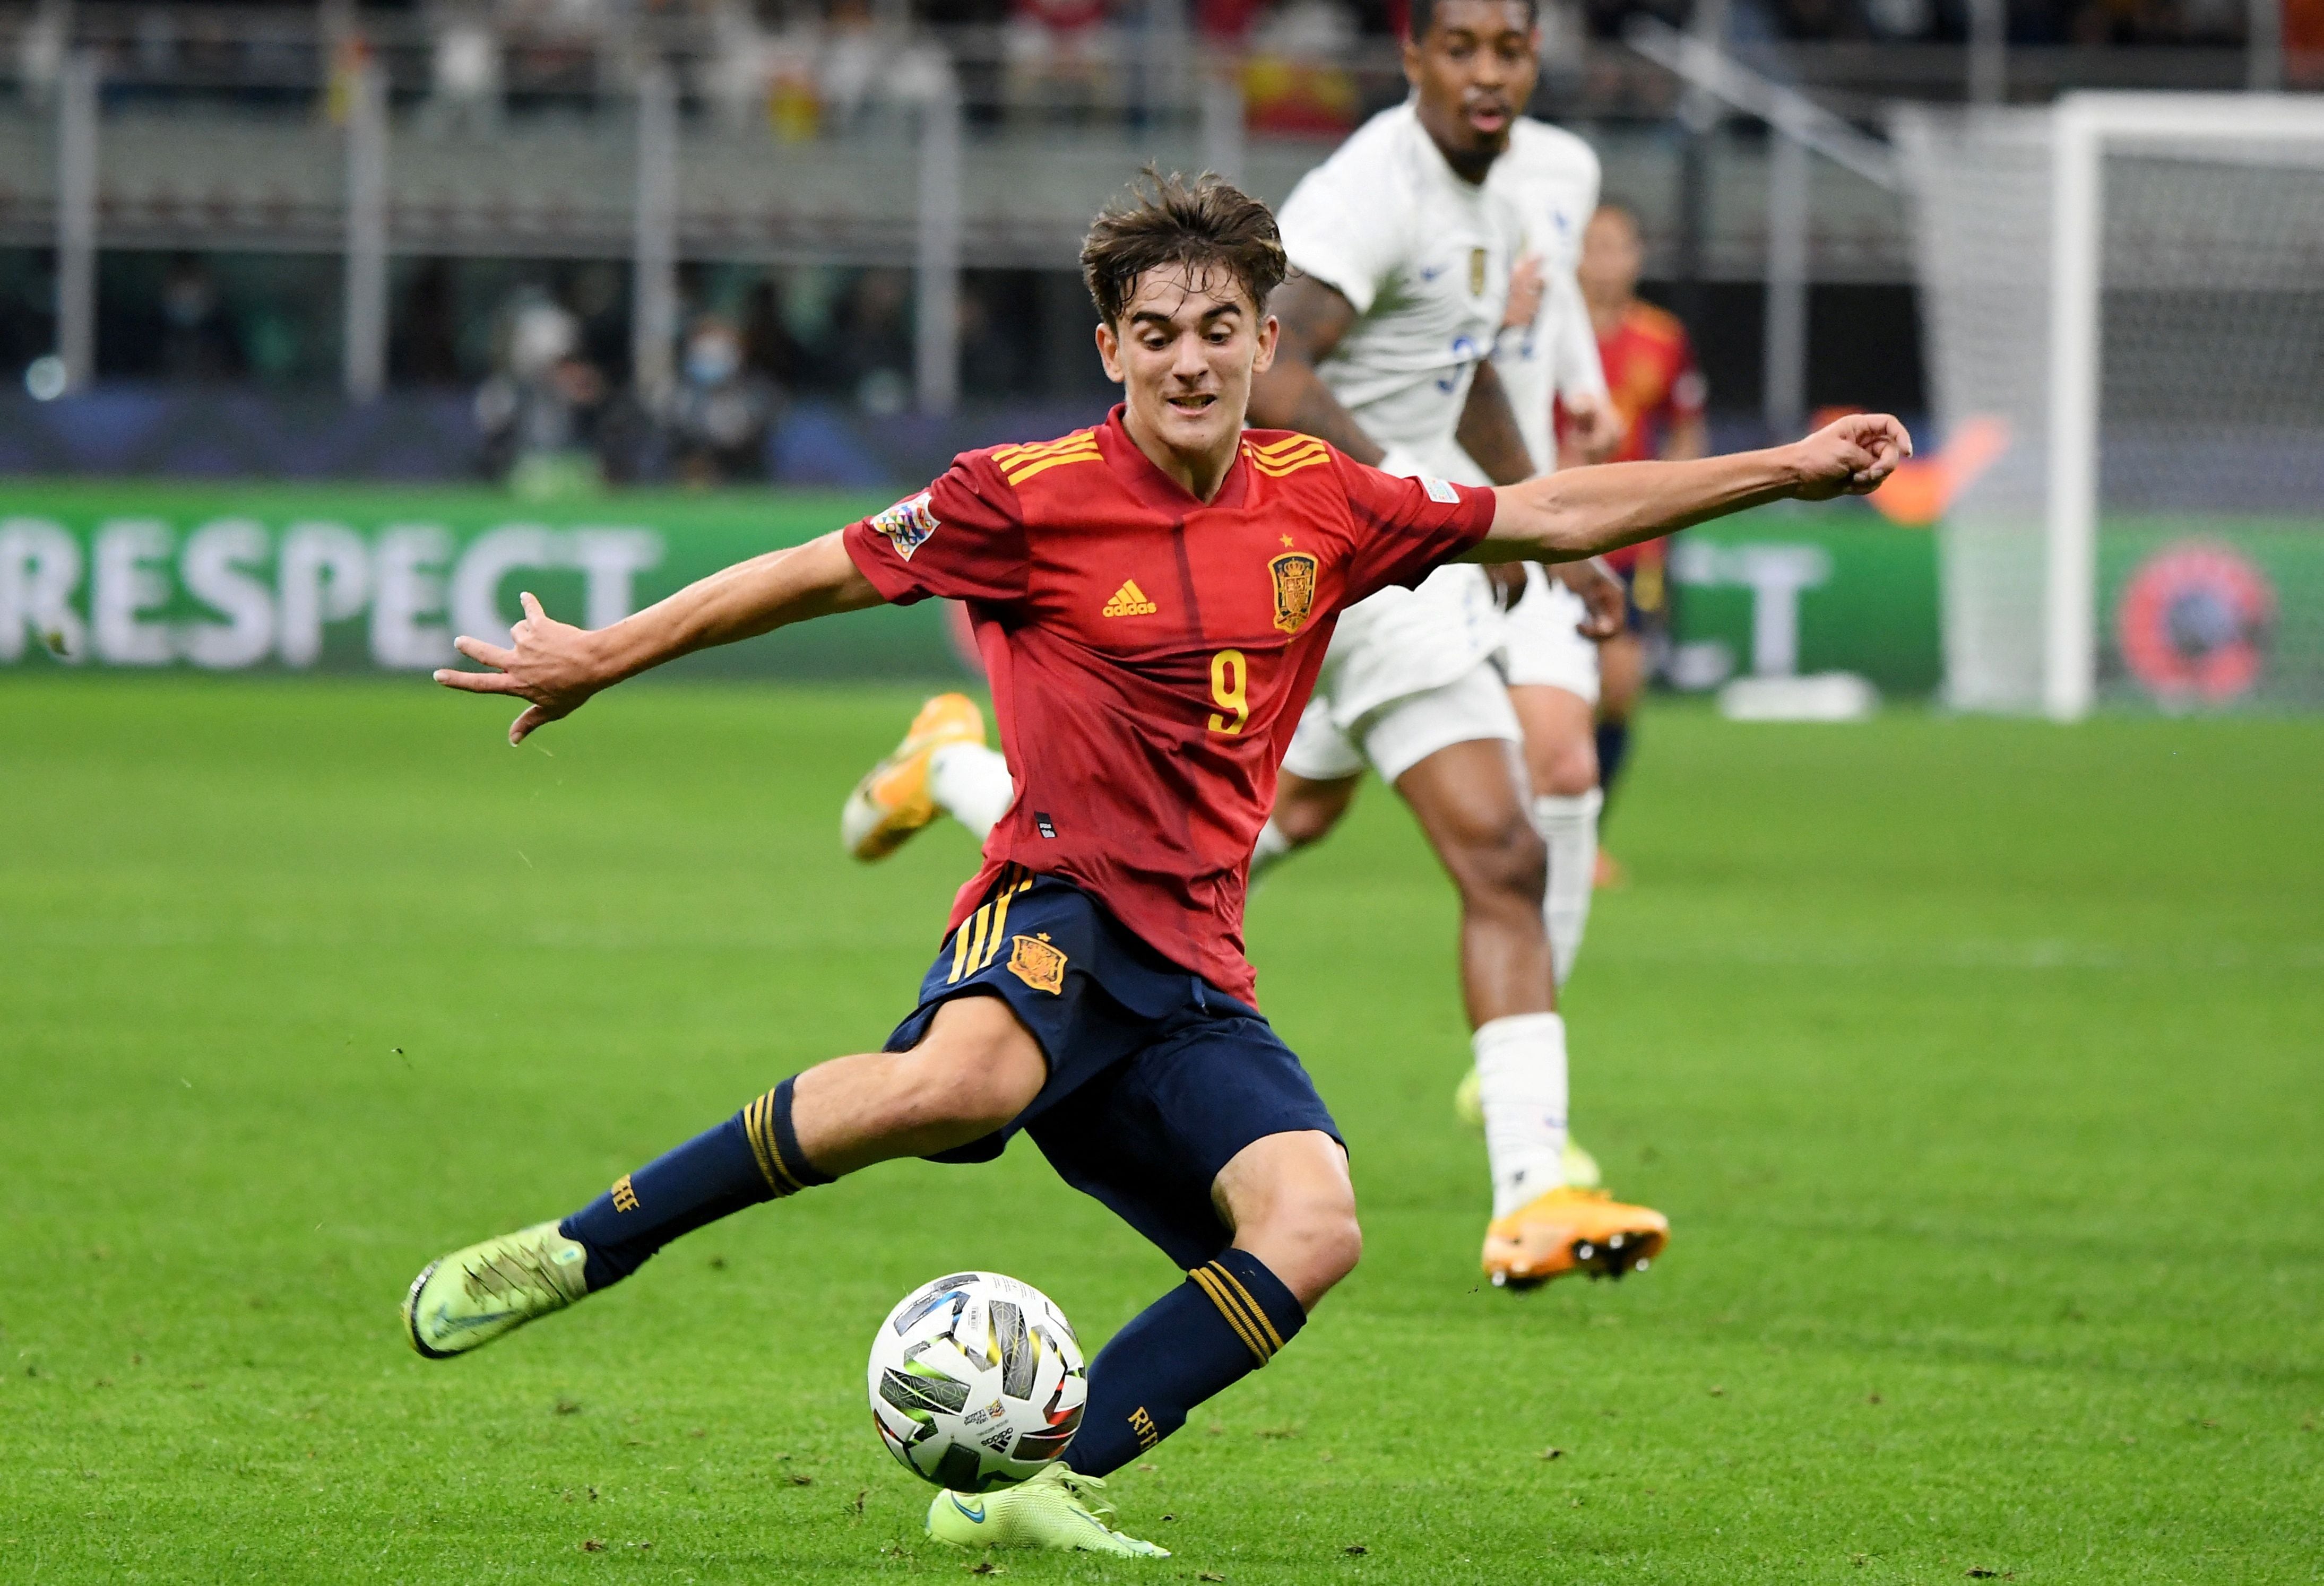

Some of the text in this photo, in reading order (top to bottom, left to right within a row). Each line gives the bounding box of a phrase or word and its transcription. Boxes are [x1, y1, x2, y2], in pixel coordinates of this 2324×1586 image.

[0, 516, 663, 669] RESPECT
[1102, 601, 1157, 618] adidas
[1208, 649, 1249, 735] 9
[980, 1427, 1014, 1446] adidas
